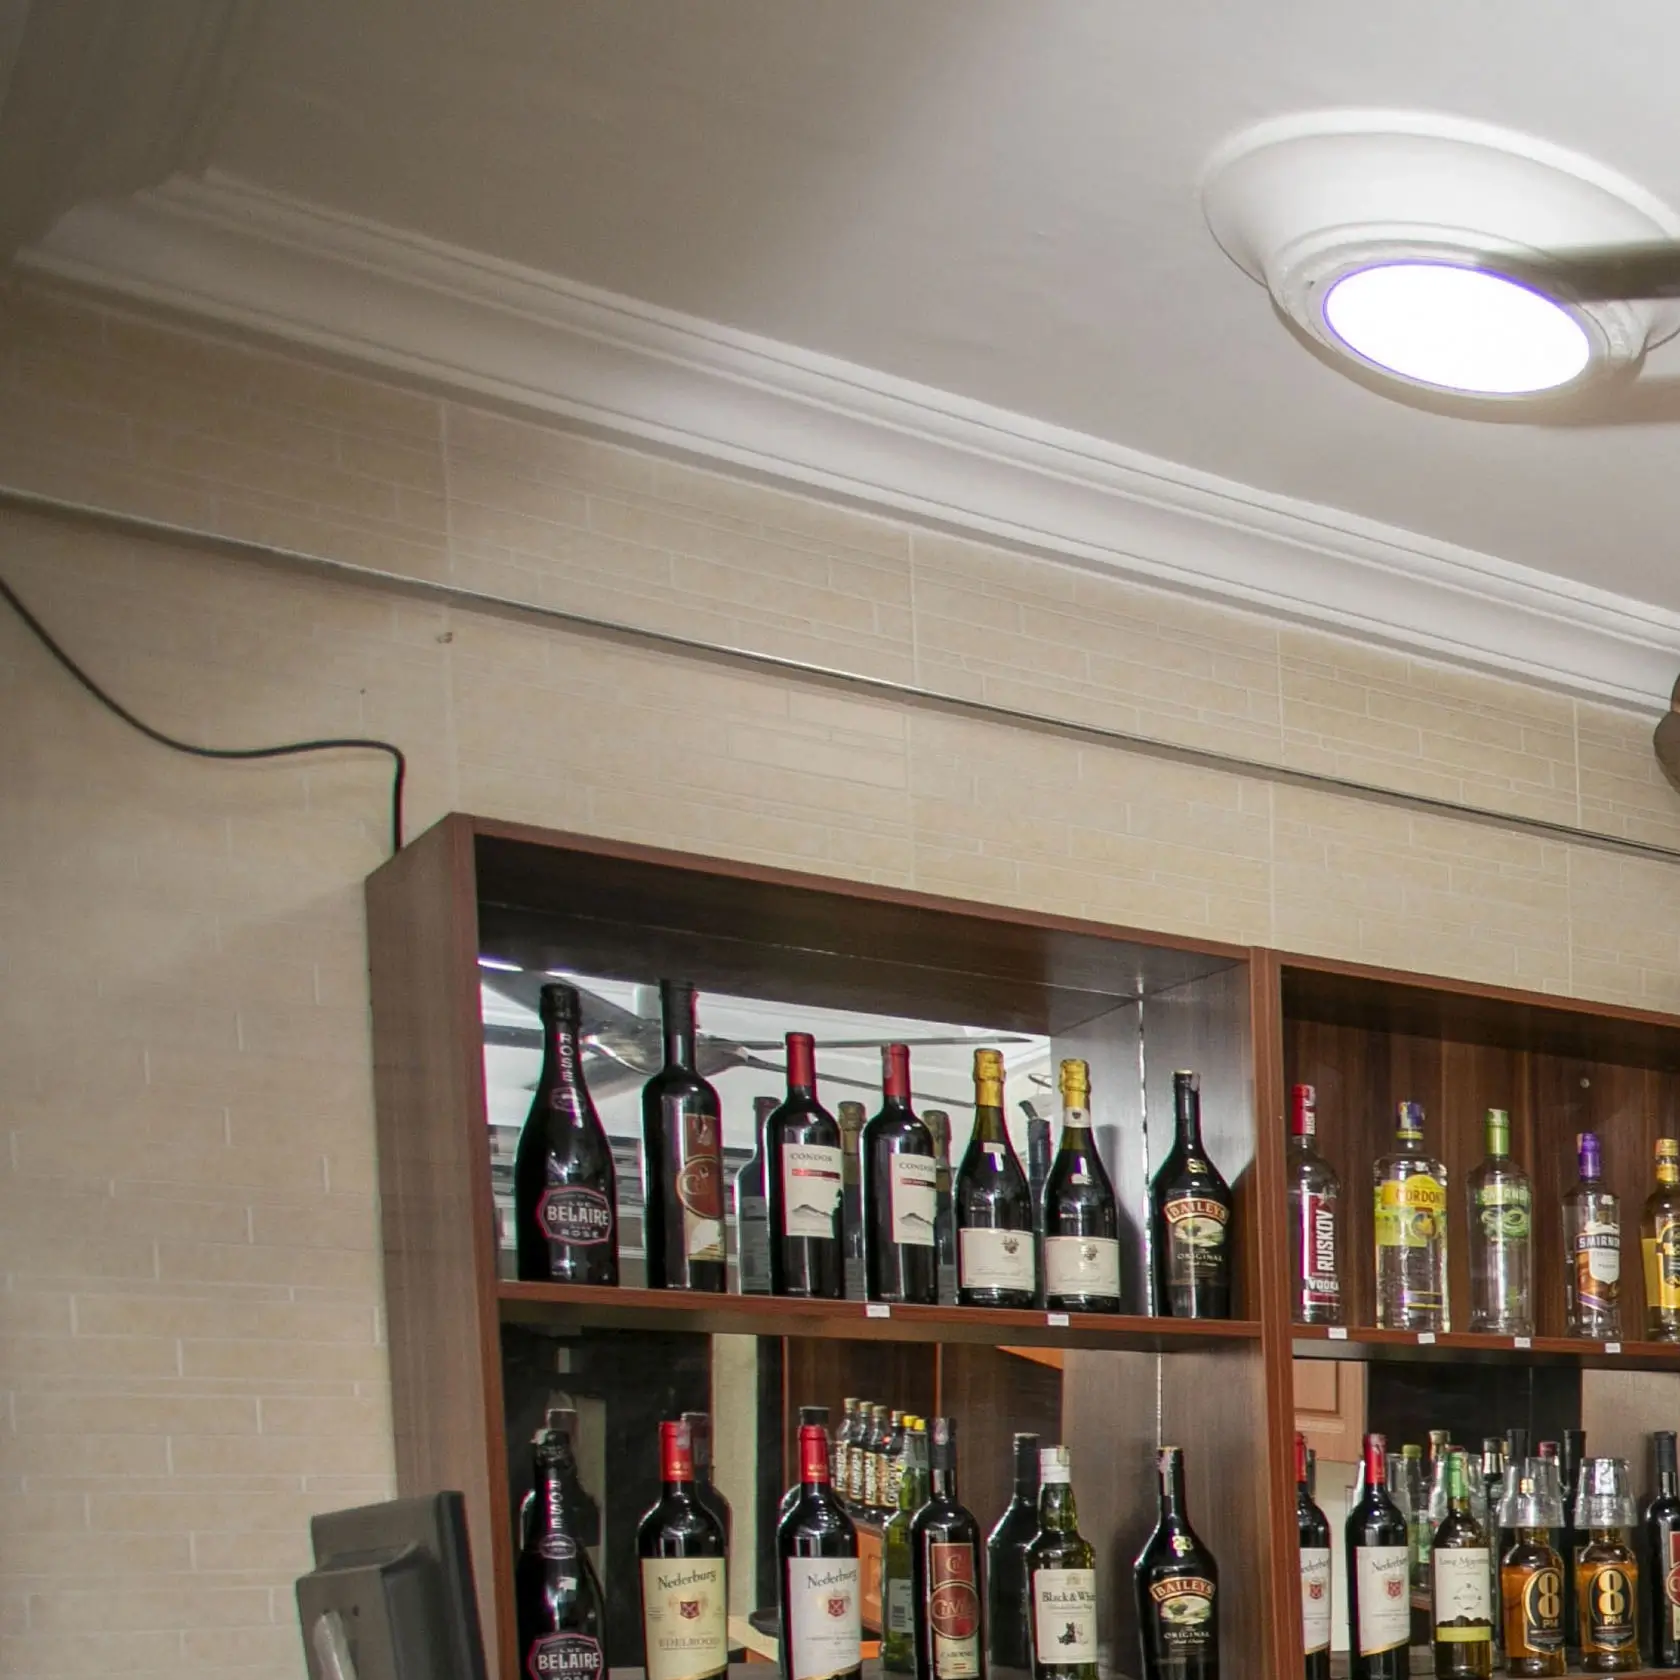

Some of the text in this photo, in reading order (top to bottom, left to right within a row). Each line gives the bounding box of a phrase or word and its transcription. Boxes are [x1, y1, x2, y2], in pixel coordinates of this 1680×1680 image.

[547, 1205, 610, 1227] BELAIRE
[1168, 1200, 1227, 1221] BAILEYS
[1316, 1209, 1334, 1271] RUSKOV
[657, 1568, 718, 1592] Nederburg
[1155, 1578, 1214, 1598] BAILEYS
[1598, 1568, 1625, 1615] 8
[1537, 1572, 1561, 1618] 8
[537, 1652, 601, 1671] BELAIRE
